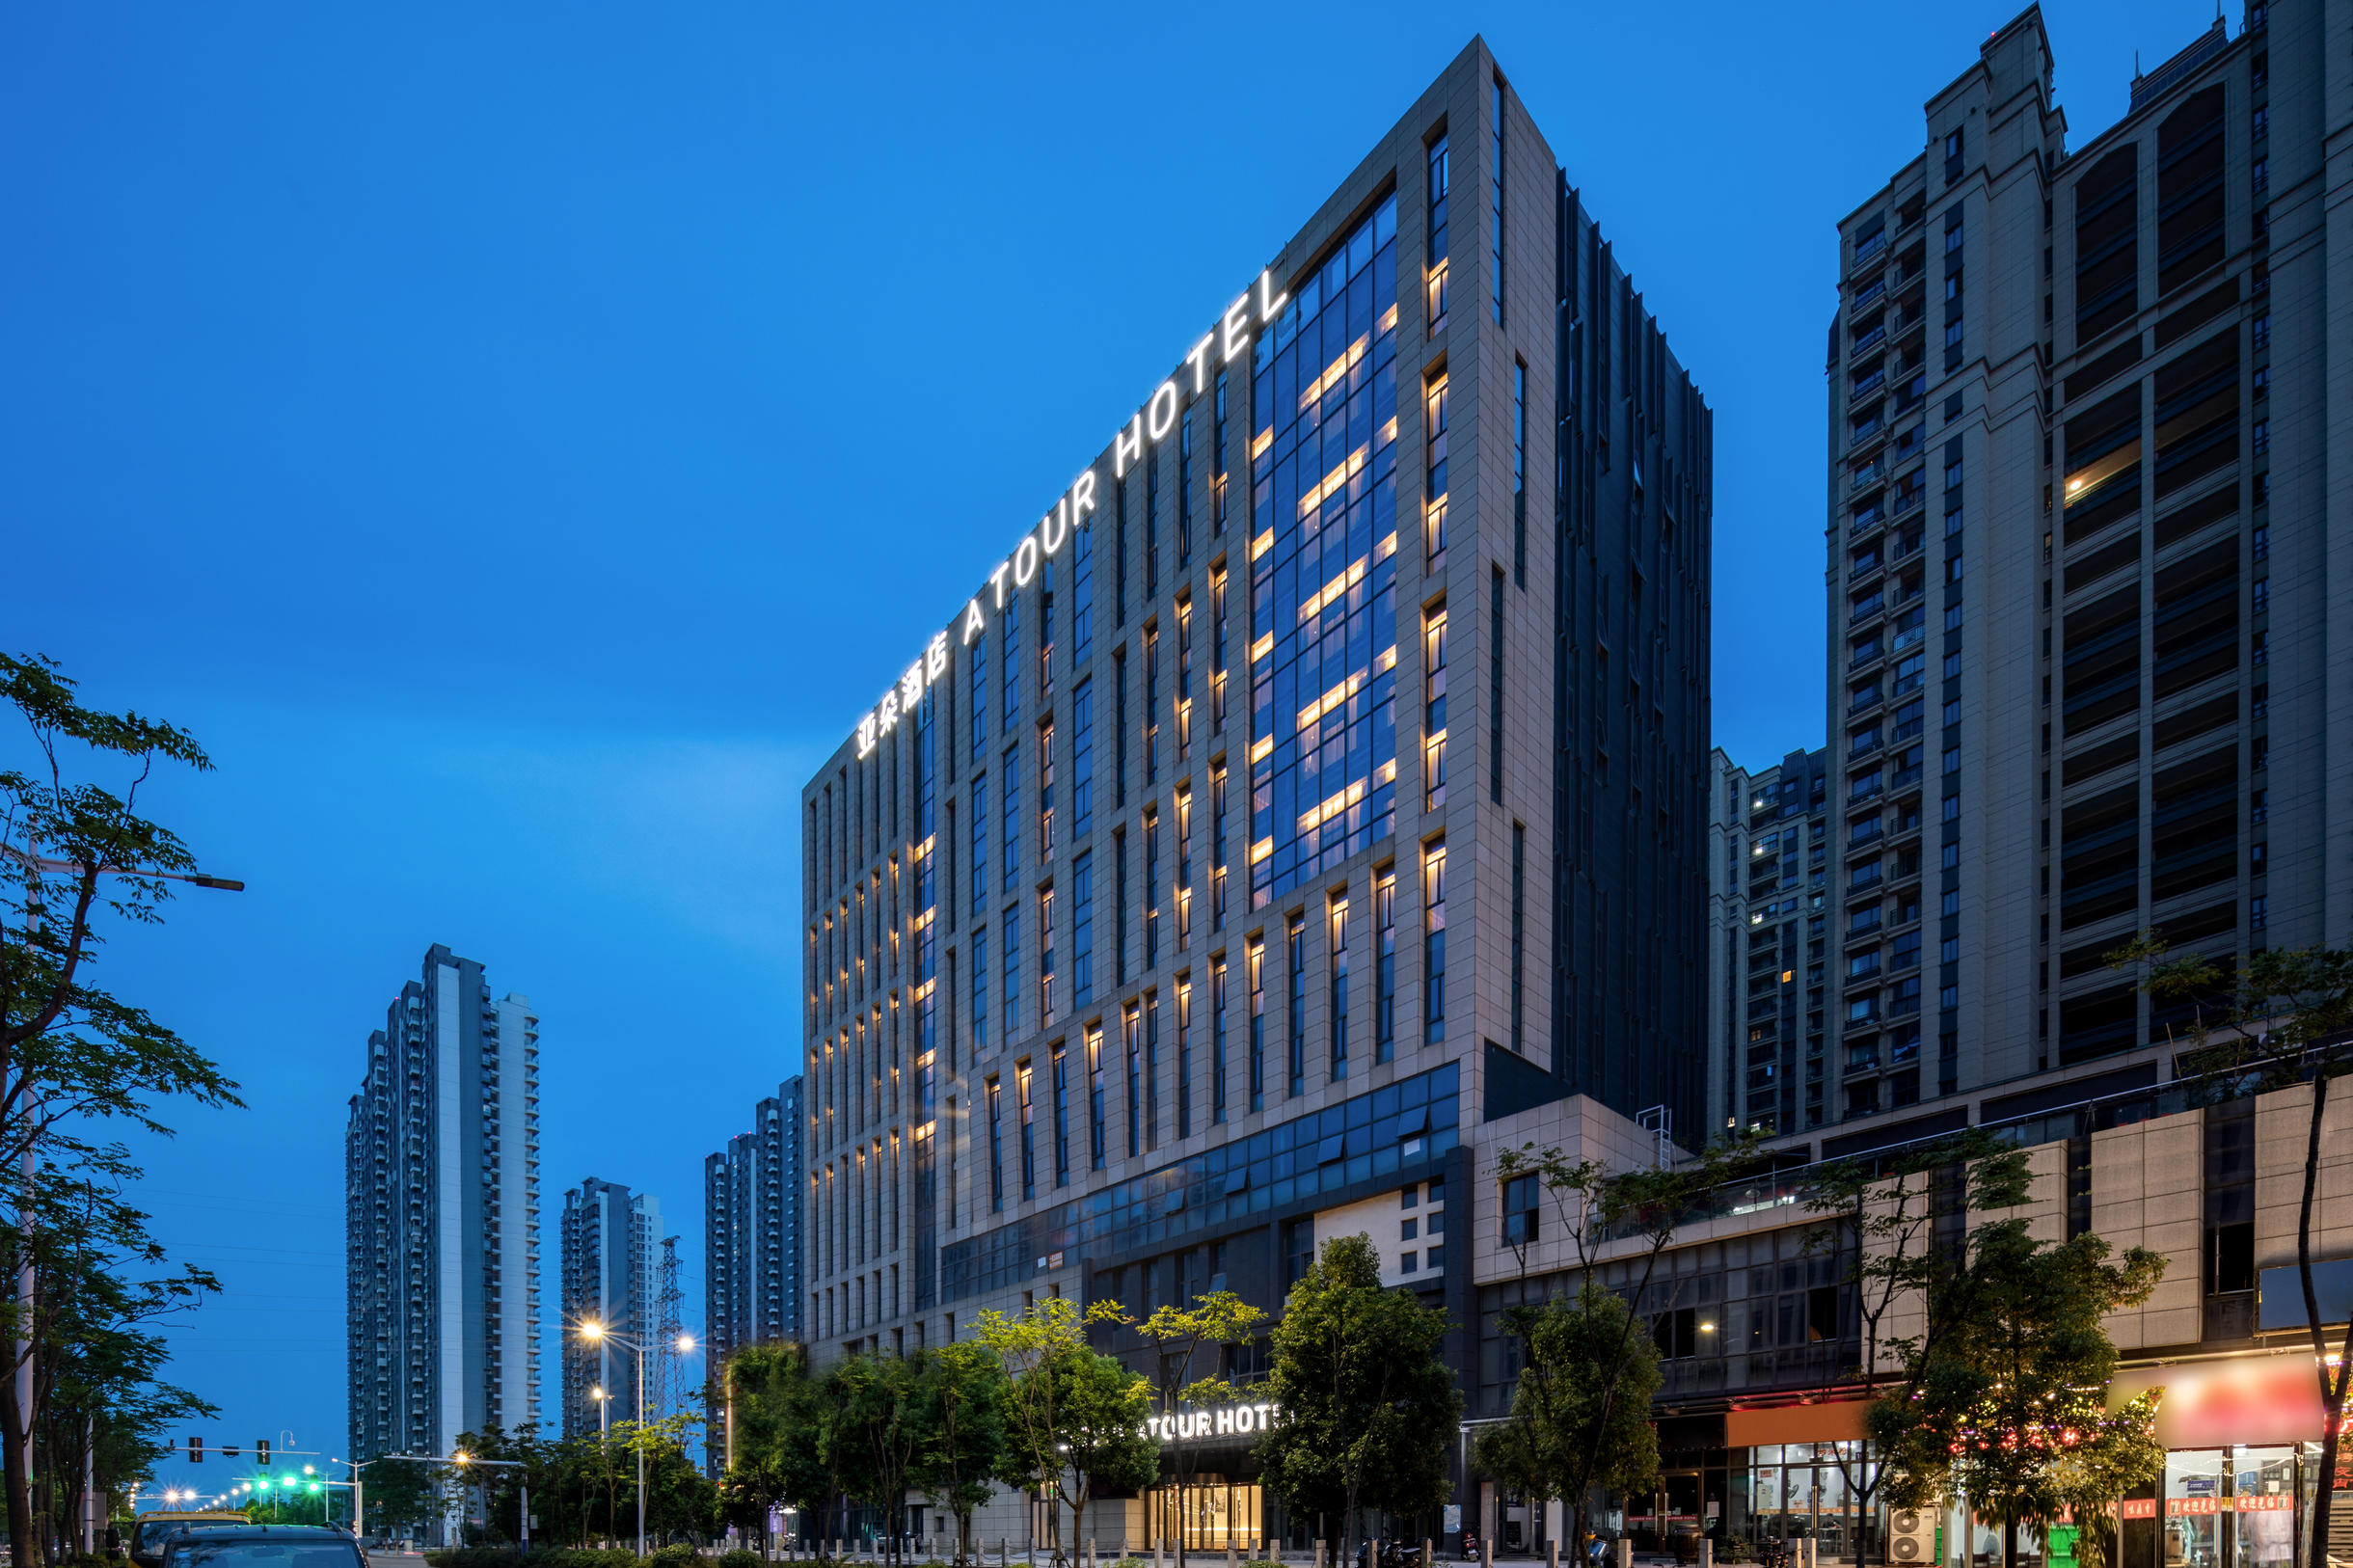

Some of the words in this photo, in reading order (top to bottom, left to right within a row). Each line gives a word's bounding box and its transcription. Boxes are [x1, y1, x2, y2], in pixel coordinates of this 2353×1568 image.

[857, 630, 948, 760] 亚朵酒店
[962, 470, 1096, 646] ATOUR
[1115, 269, 1287, 479] HOTEL
[2182, 1499, 2216, 1513] 欢迎光临
[2239, 1497, 2275, 1510] 欢迎光临
